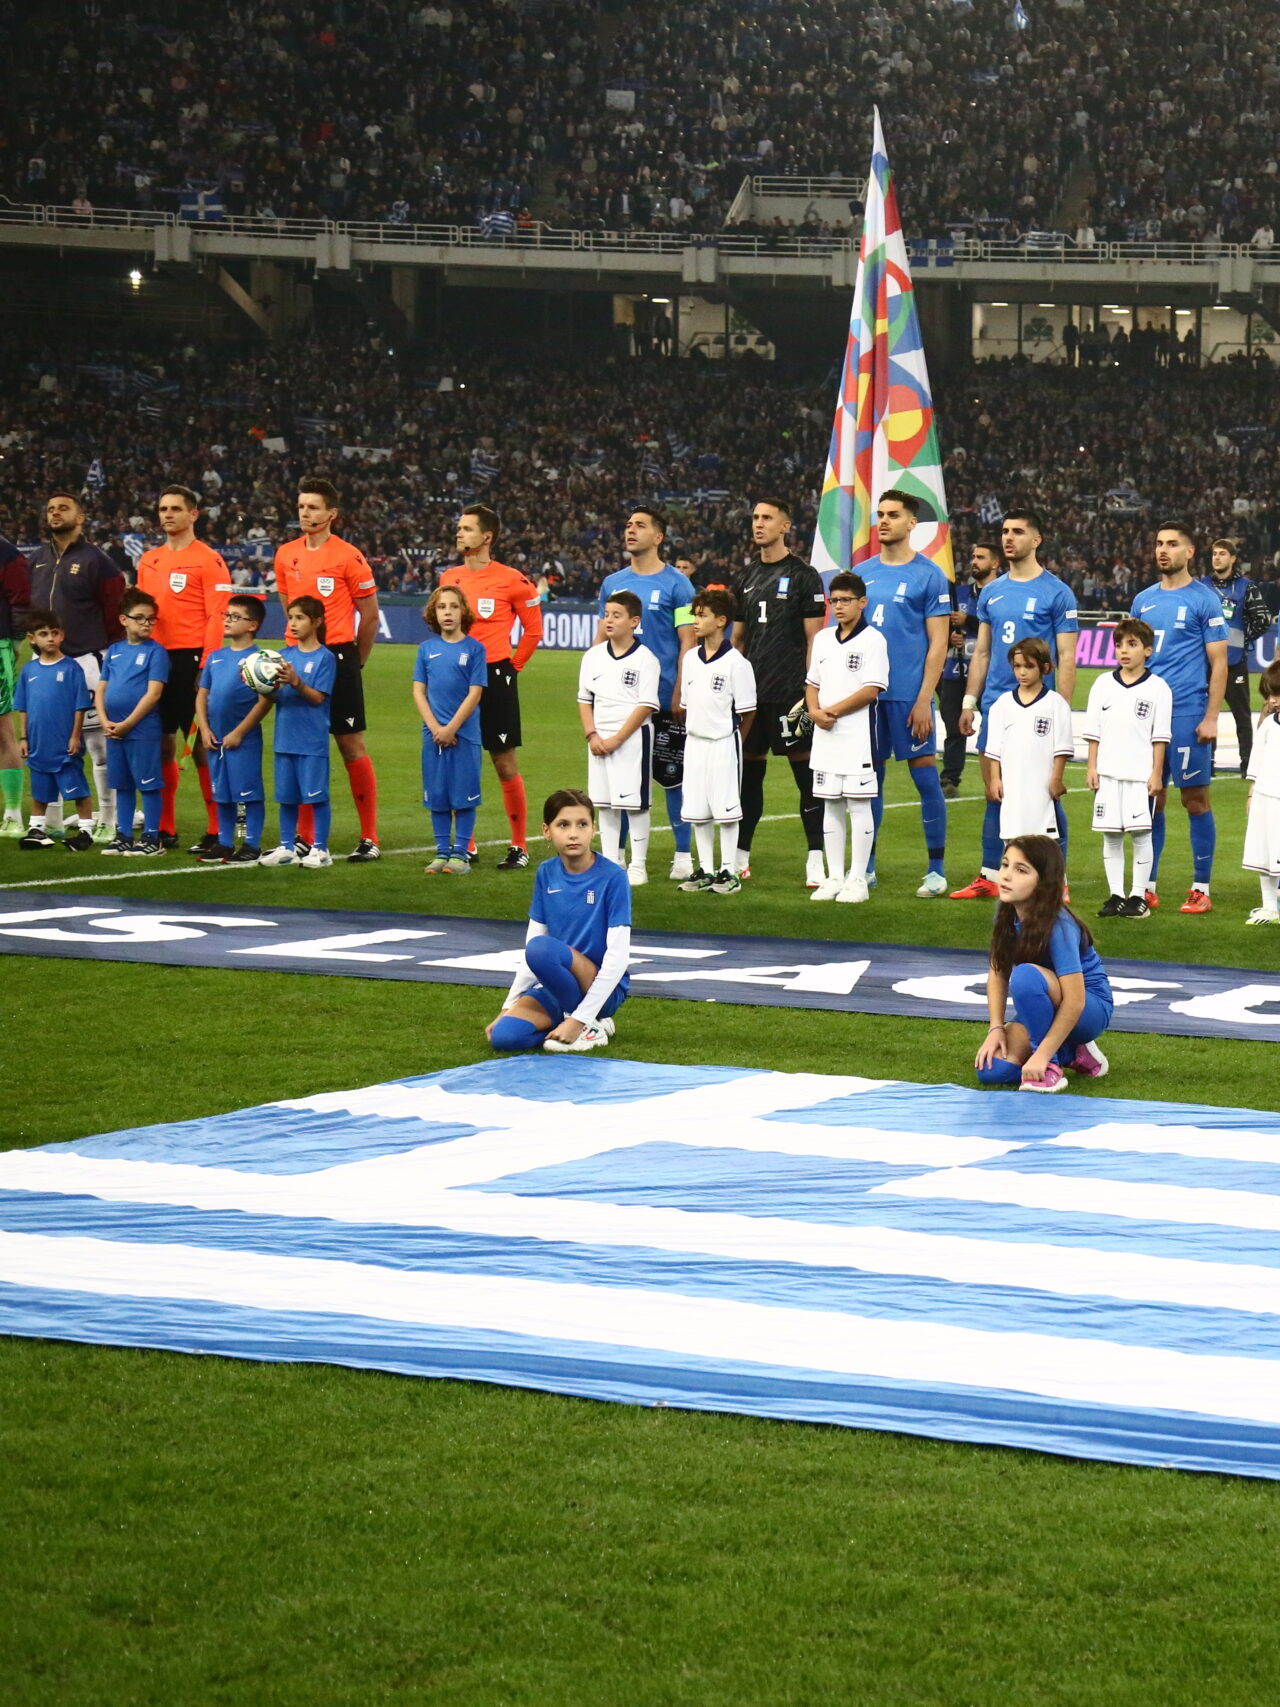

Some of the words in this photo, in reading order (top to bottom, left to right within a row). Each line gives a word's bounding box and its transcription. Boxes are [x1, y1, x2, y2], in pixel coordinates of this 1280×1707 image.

[758, 600, 768, 623] 1
[872, 603, 885, 627] 4
[1001, 620, 1016, 644] 3
[1153, 629, 1166, 653] 7
[779, 715, 793, 738] 1
[1177, 746, 1191, 770] 7
